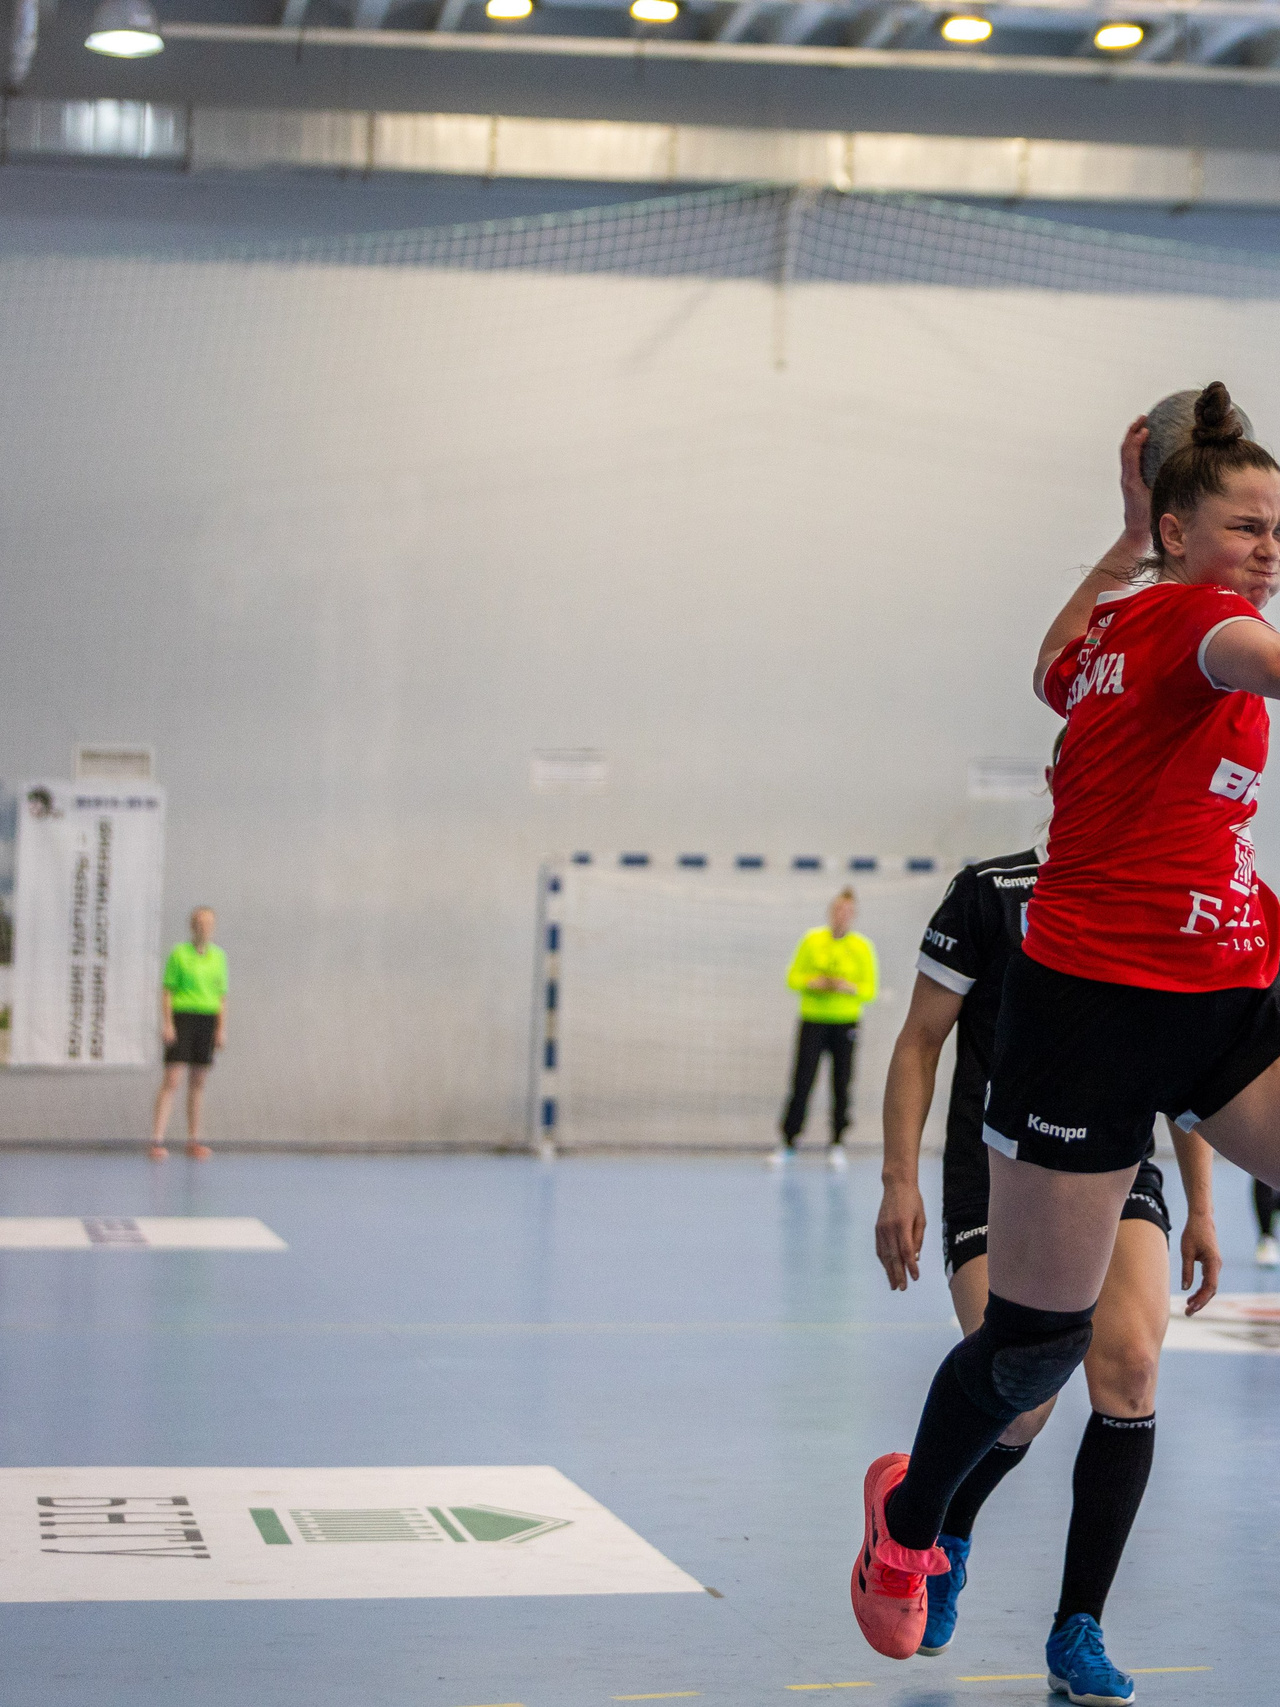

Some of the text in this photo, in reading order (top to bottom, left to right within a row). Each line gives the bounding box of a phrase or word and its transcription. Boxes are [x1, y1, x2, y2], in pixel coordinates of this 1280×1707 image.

[1027, 1113, 1087, 1142] Kempa
[955, 1224, 989, 1244] Kemp
[1102, 1418, 1156, 1429] Kemp
[37, 1495, 212, 1560] БНТУ
